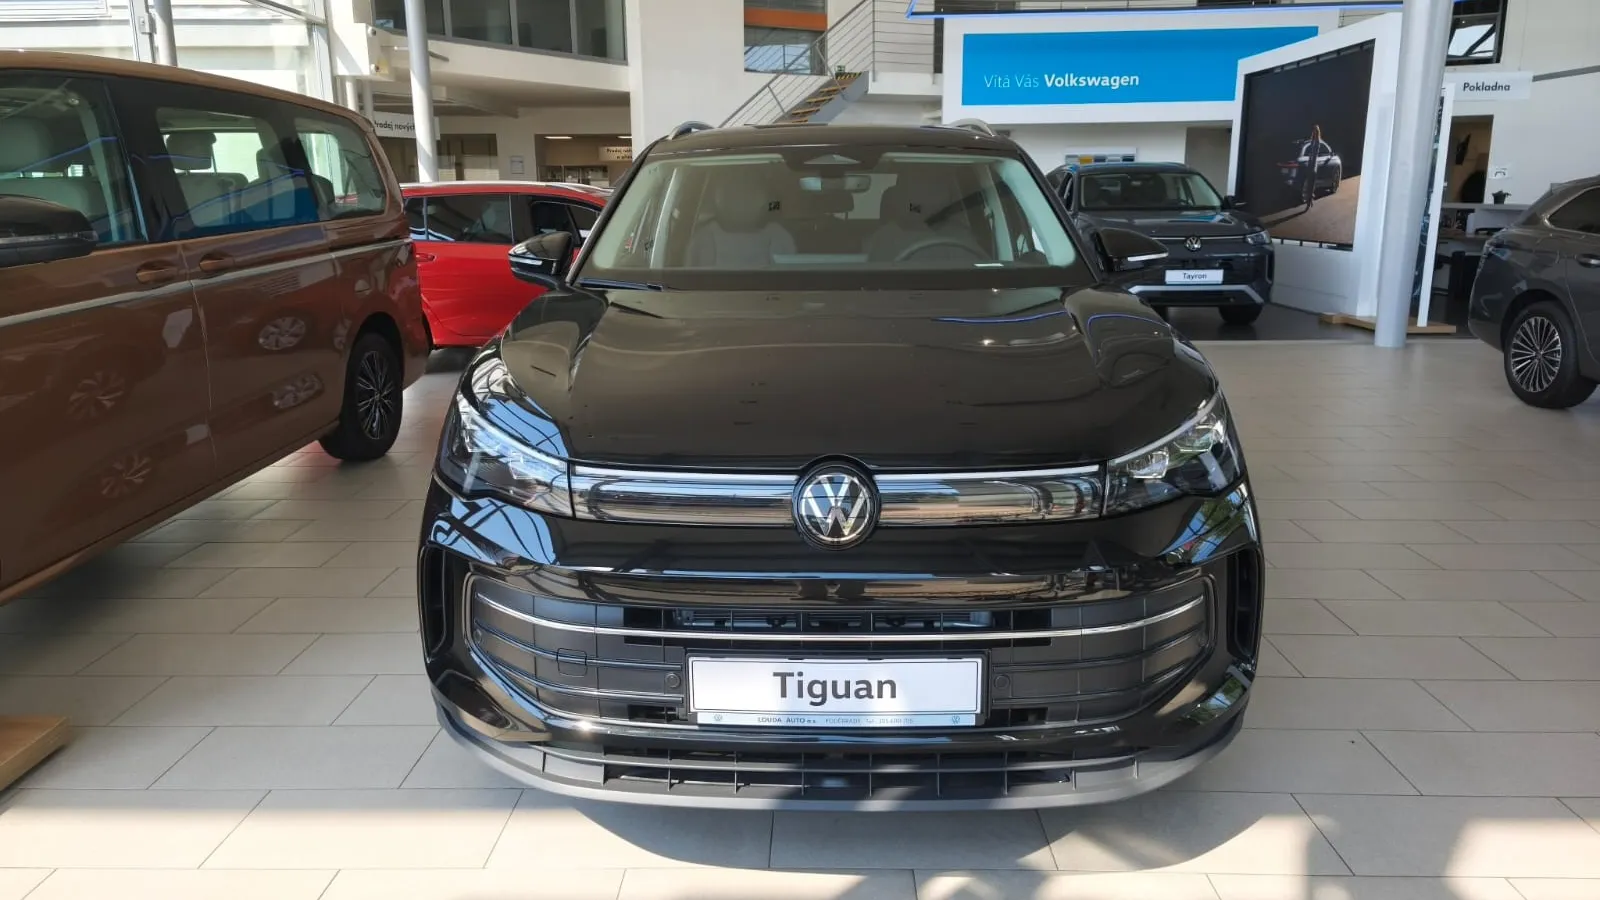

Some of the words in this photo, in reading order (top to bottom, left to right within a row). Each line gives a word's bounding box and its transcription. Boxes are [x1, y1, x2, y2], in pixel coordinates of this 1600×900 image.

[983, 73, 1011, 88] Vítá
[1014, 73, 1040, 88] Vás
[1044, 72, 1140, 90] Volkswagen
[1462, 81, 1511, 92] Pokladna
[1183, 272, 1207, 280] Tayron
[773, 671, 897, 707] Tiguan
